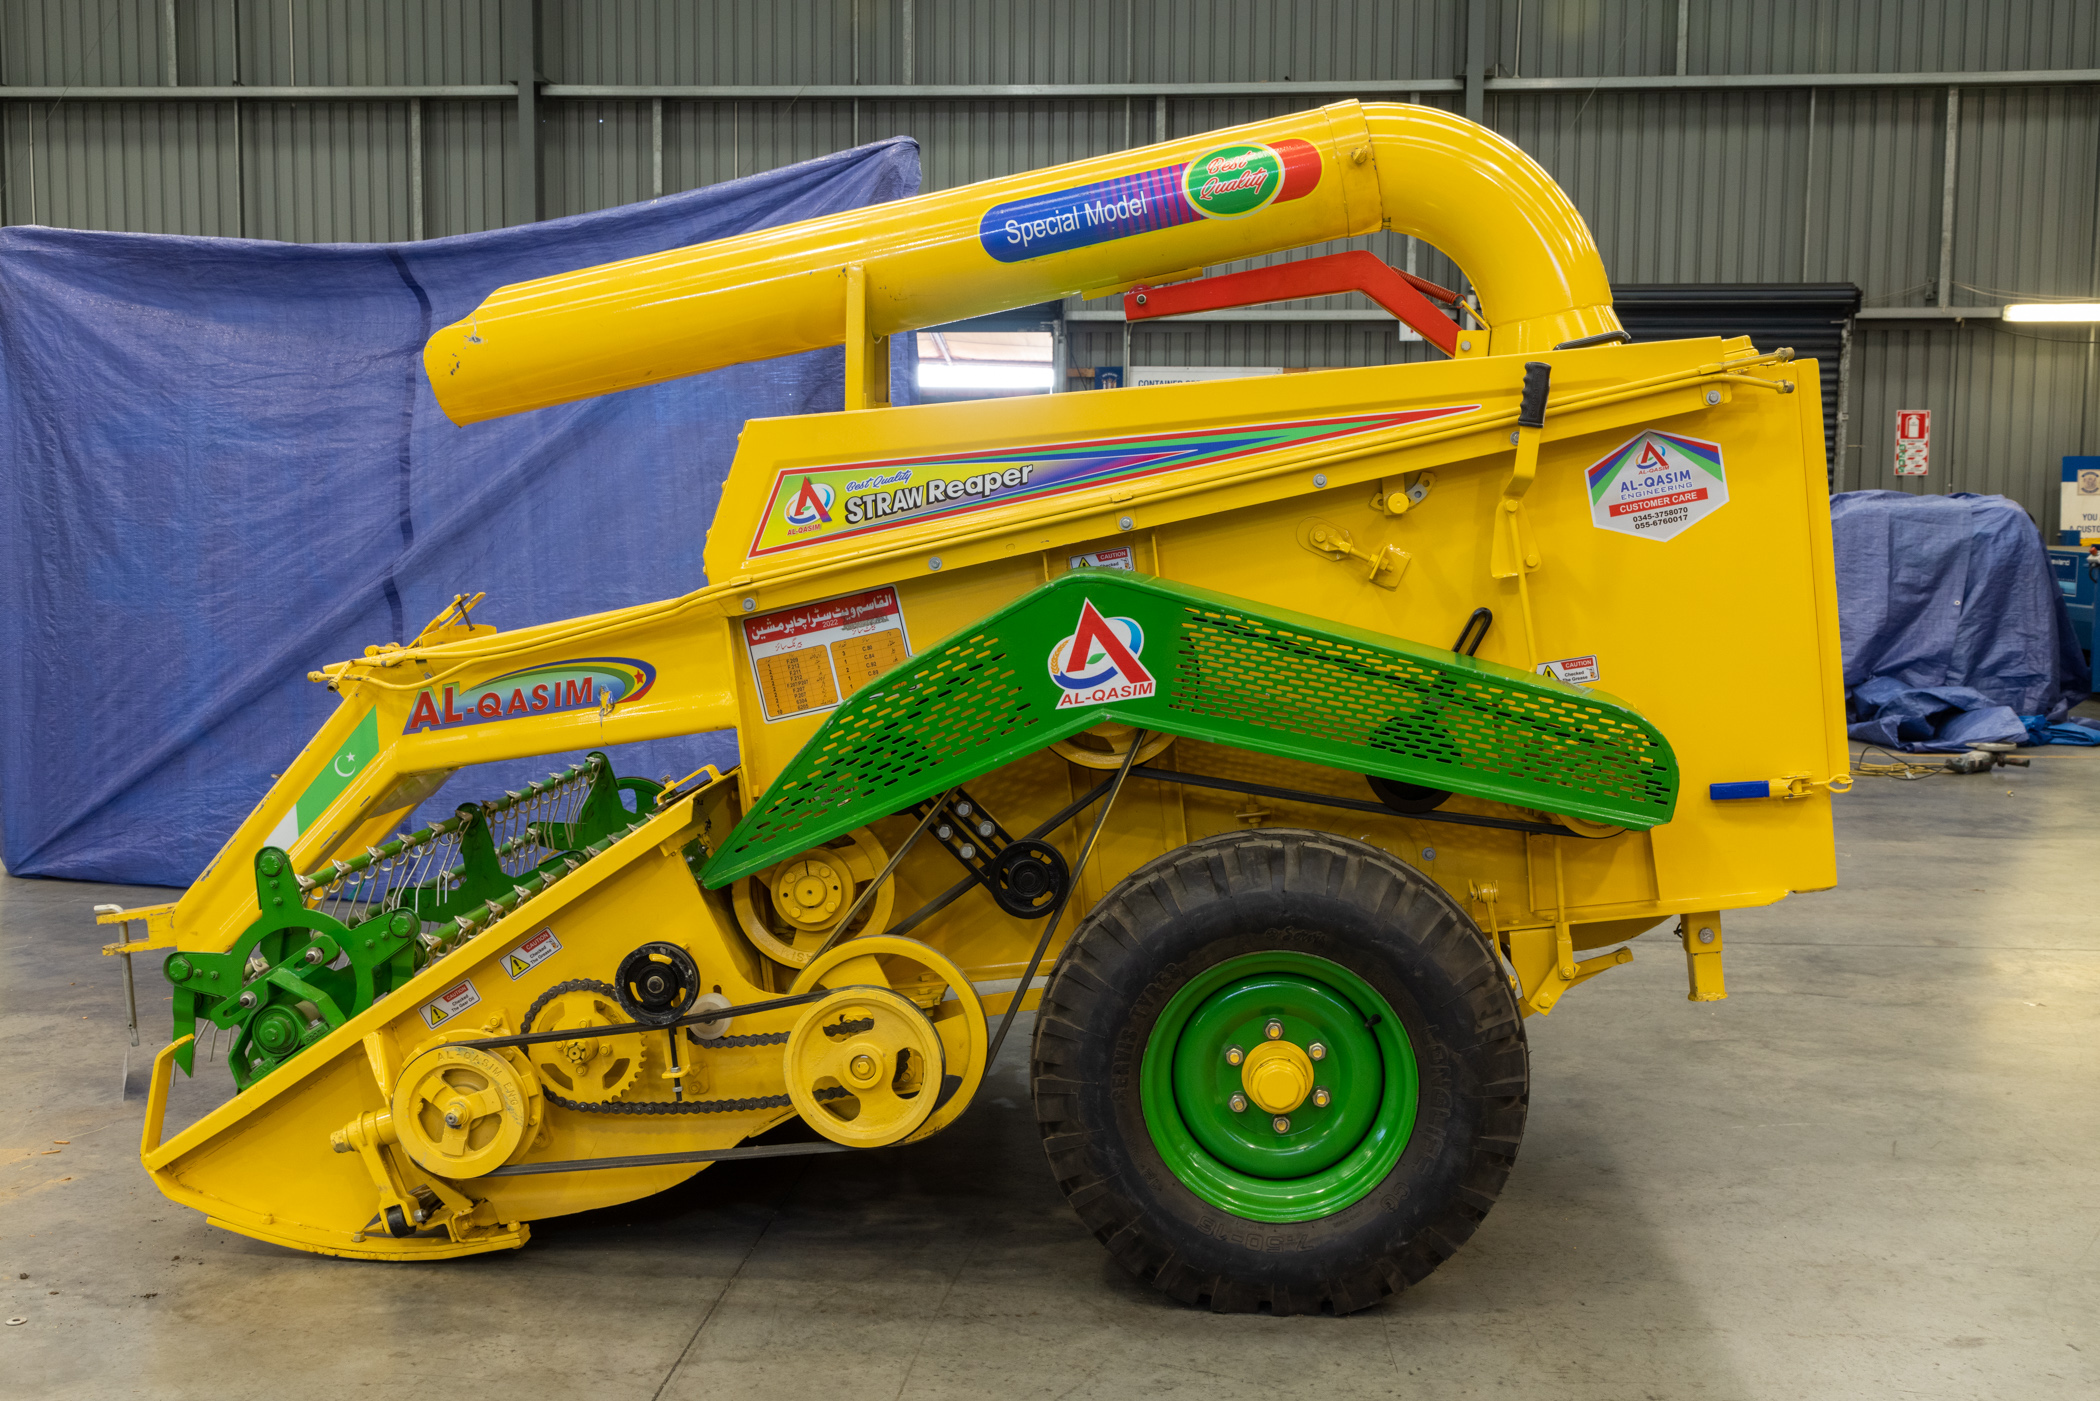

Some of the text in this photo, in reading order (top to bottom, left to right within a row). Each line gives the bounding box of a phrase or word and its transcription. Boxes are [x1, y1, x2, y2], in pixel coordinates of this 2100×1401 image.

[1207, 151, 1253, 175] Best
[1200, 170, 1269, 200] Quality
[1005, 191, 1148, 247] Special Model
[1638, 465, 1670, 475] AL-QASIM
[846, 469, 913, 493] Best Quality
[1621, 470, 1692, 493] AL-QASIM
[845, 465, 1033, 524] STRAW Reaper
[1621, 482, 1693, 501] ENGINEERING
[1620, 492, 1698, 513] CUSTOMER CARE
[1633, 507, 1689, 523] 0345-3758070
[1635, 514, 1689, 530] 055-6760017
[787, 524, 821, 536] AL-QASIM
[1101, 551, 1126, 560] CAUTION
[752, 619, 783, 640] مشین
[822, 619, 839, 628] 2022
[1565, 660, 1592, 669] CAUTION
[409, 677, 594, 729] AL-QASIM
[1060, 682, 1153, 707] AL-QASIM
[525, 932, 549, 950] CAUTION
[446, 986, 467, 1001] CAUTION
